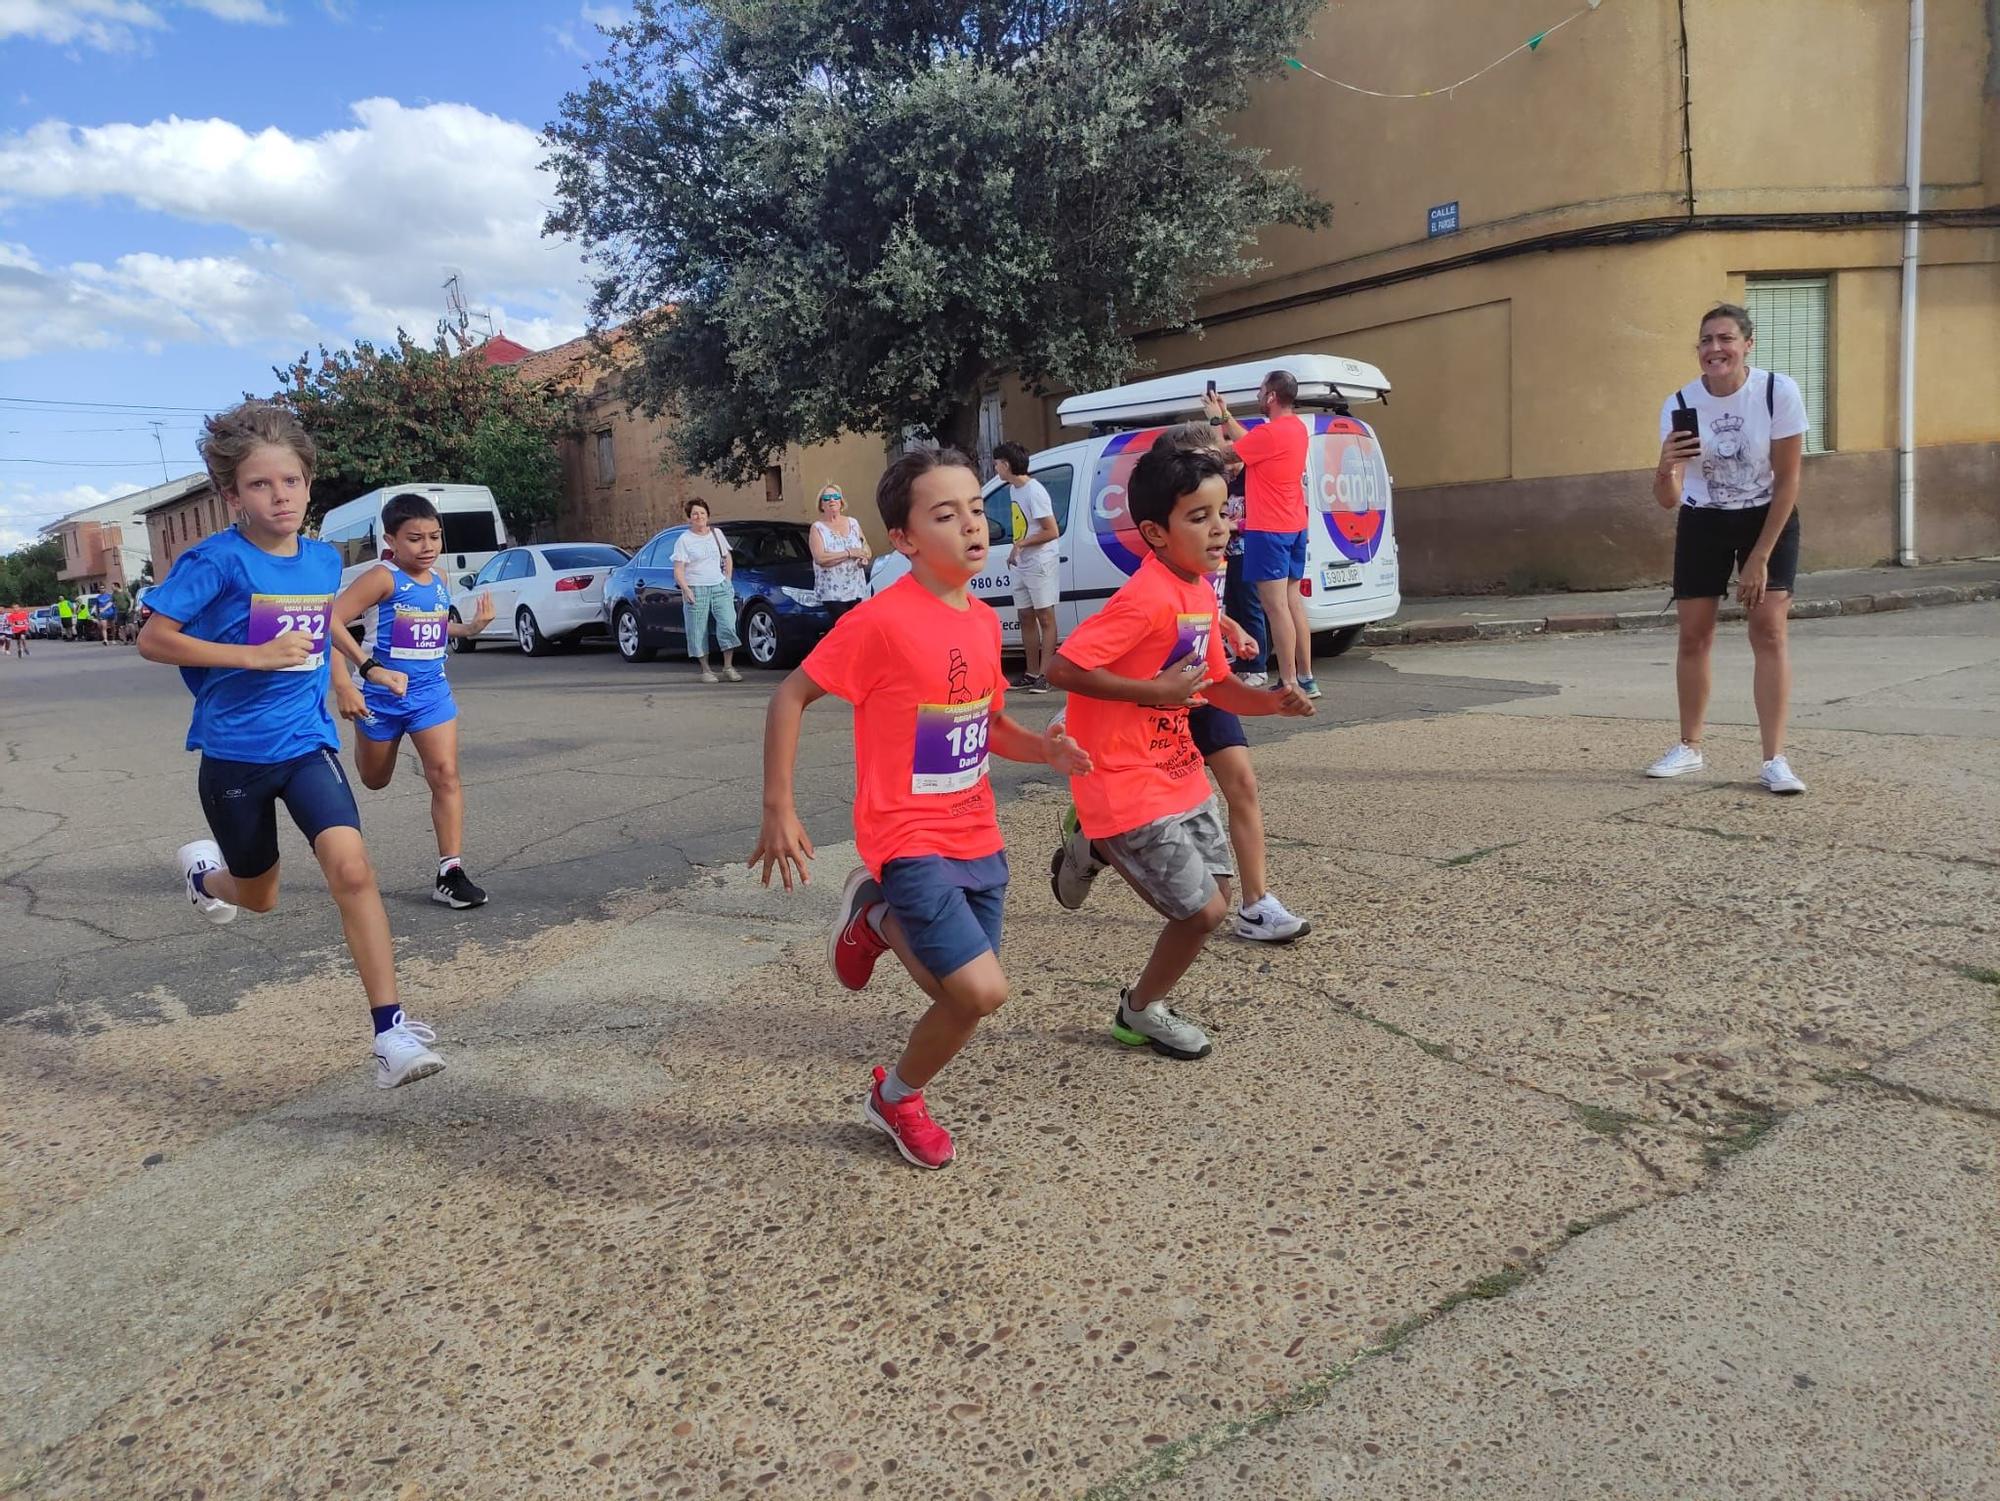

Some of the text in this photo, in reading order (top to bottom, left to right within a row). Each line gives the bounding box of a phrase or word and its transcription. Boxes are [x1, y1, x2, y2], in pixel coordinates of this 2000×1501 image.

[1431, 205, 1457, 218] CALLE
[1319, 459, 1379, 504] canal
[970, 575, 1010, 589] 980 63
[275, 614, 325, 640] 232
[410, 623, 441, 640] 190
[1000, 620, 1021, 630] eca
[945, 717, 989, 757] 186
